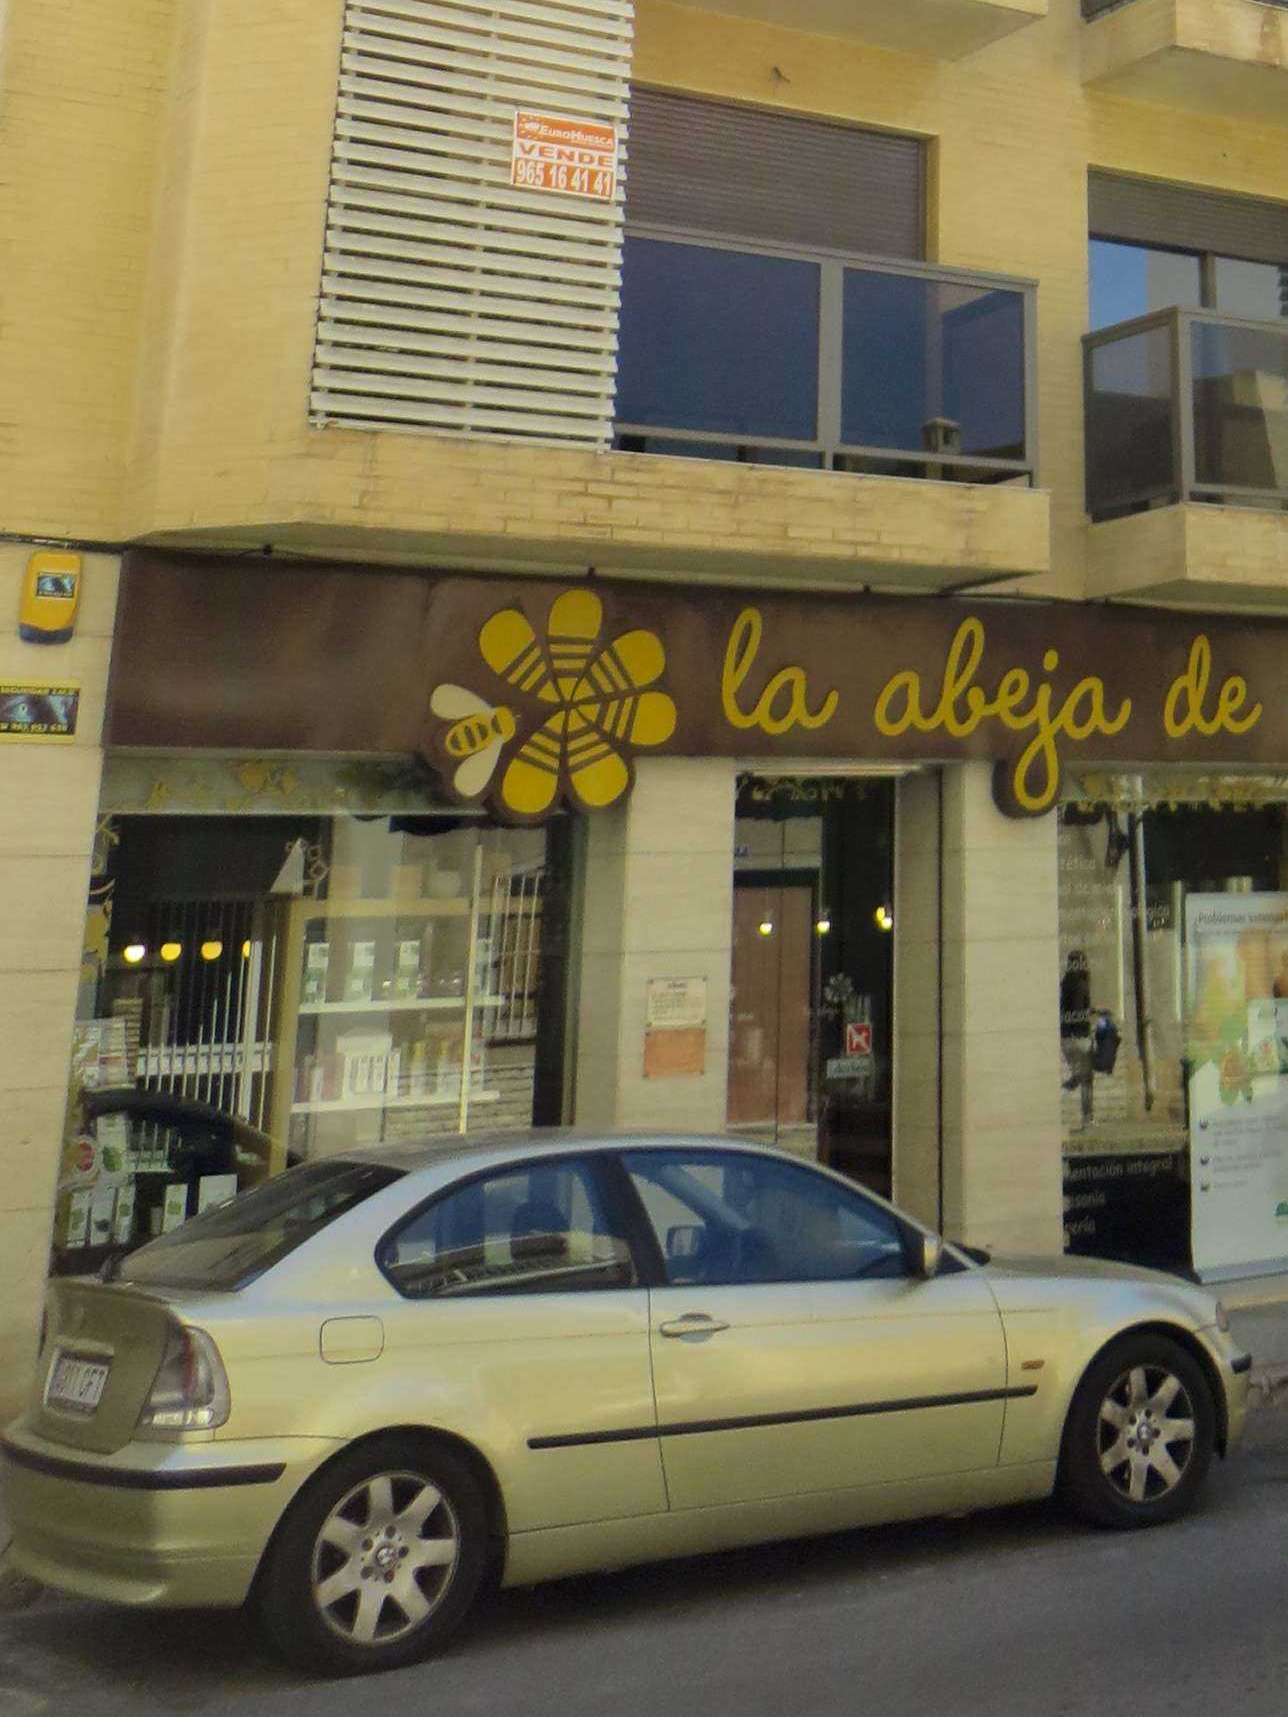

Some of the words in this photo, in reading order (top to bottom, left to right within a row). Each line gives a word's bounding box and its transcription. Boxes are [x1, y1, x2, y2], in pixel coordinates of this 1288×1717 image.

[518, 141, 613, 168] VENDE
[517, 159, 544, 187] 965
[549, 162, 567, 190] 16
[571, 167, 590, 193] 41
[593, 170, 612, 196] 41
[722, 607, 839, 736] la
[875, 617, 1132, 812] abeja
[1164, 635, 1262, 738] de
